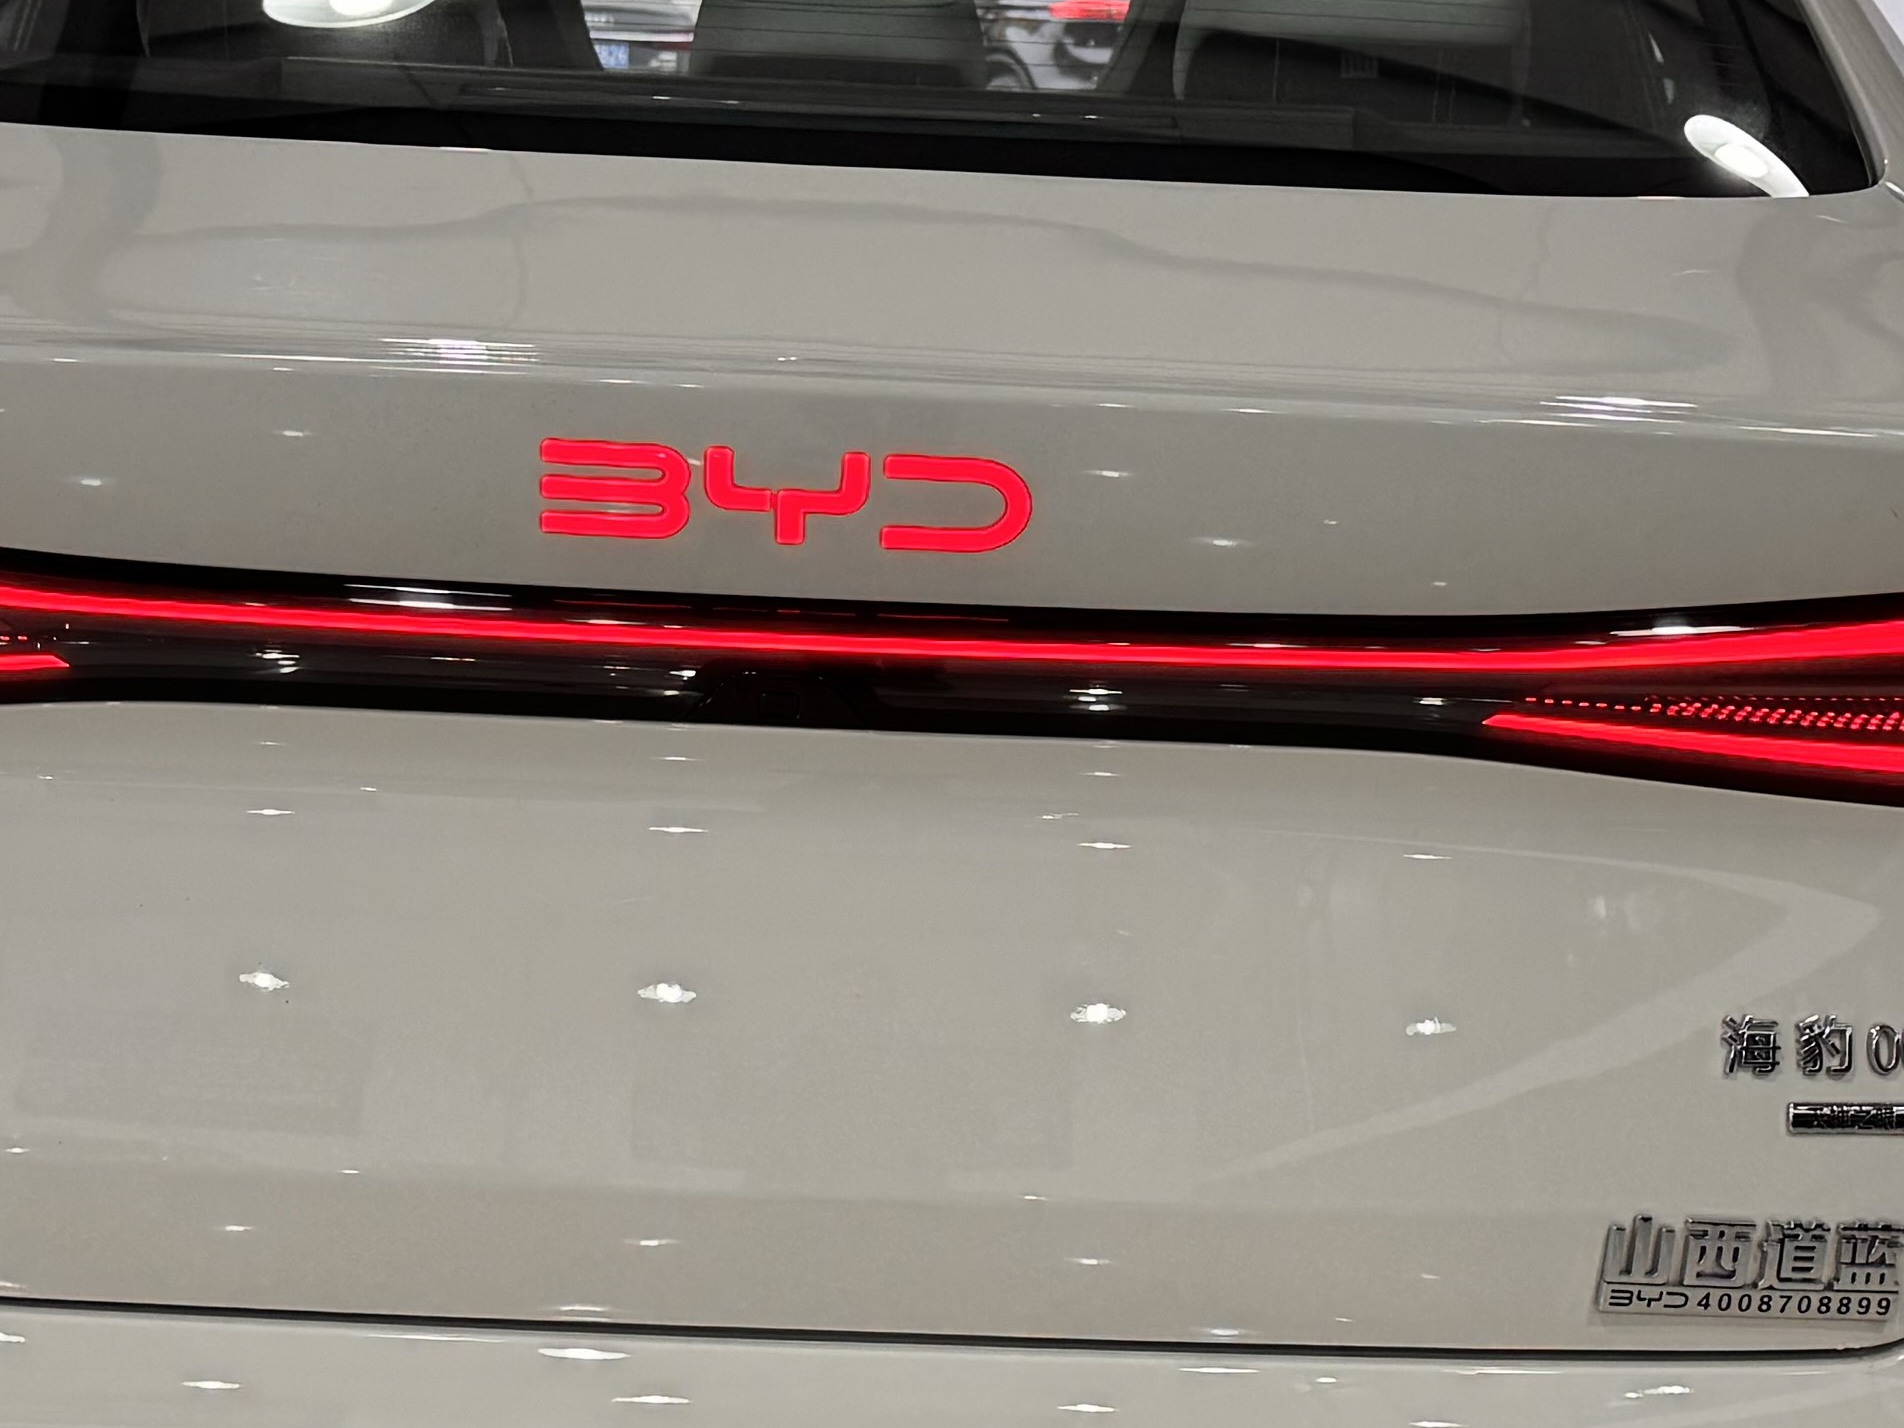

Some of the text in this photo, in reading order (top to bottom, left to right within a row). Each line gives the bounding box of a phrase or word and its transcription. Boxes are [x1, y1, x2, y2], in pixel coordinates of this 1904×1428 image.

[539, 437, 1033, 553] BYD
[1608, 1288, 1892, 1317] BYD 4008708899
